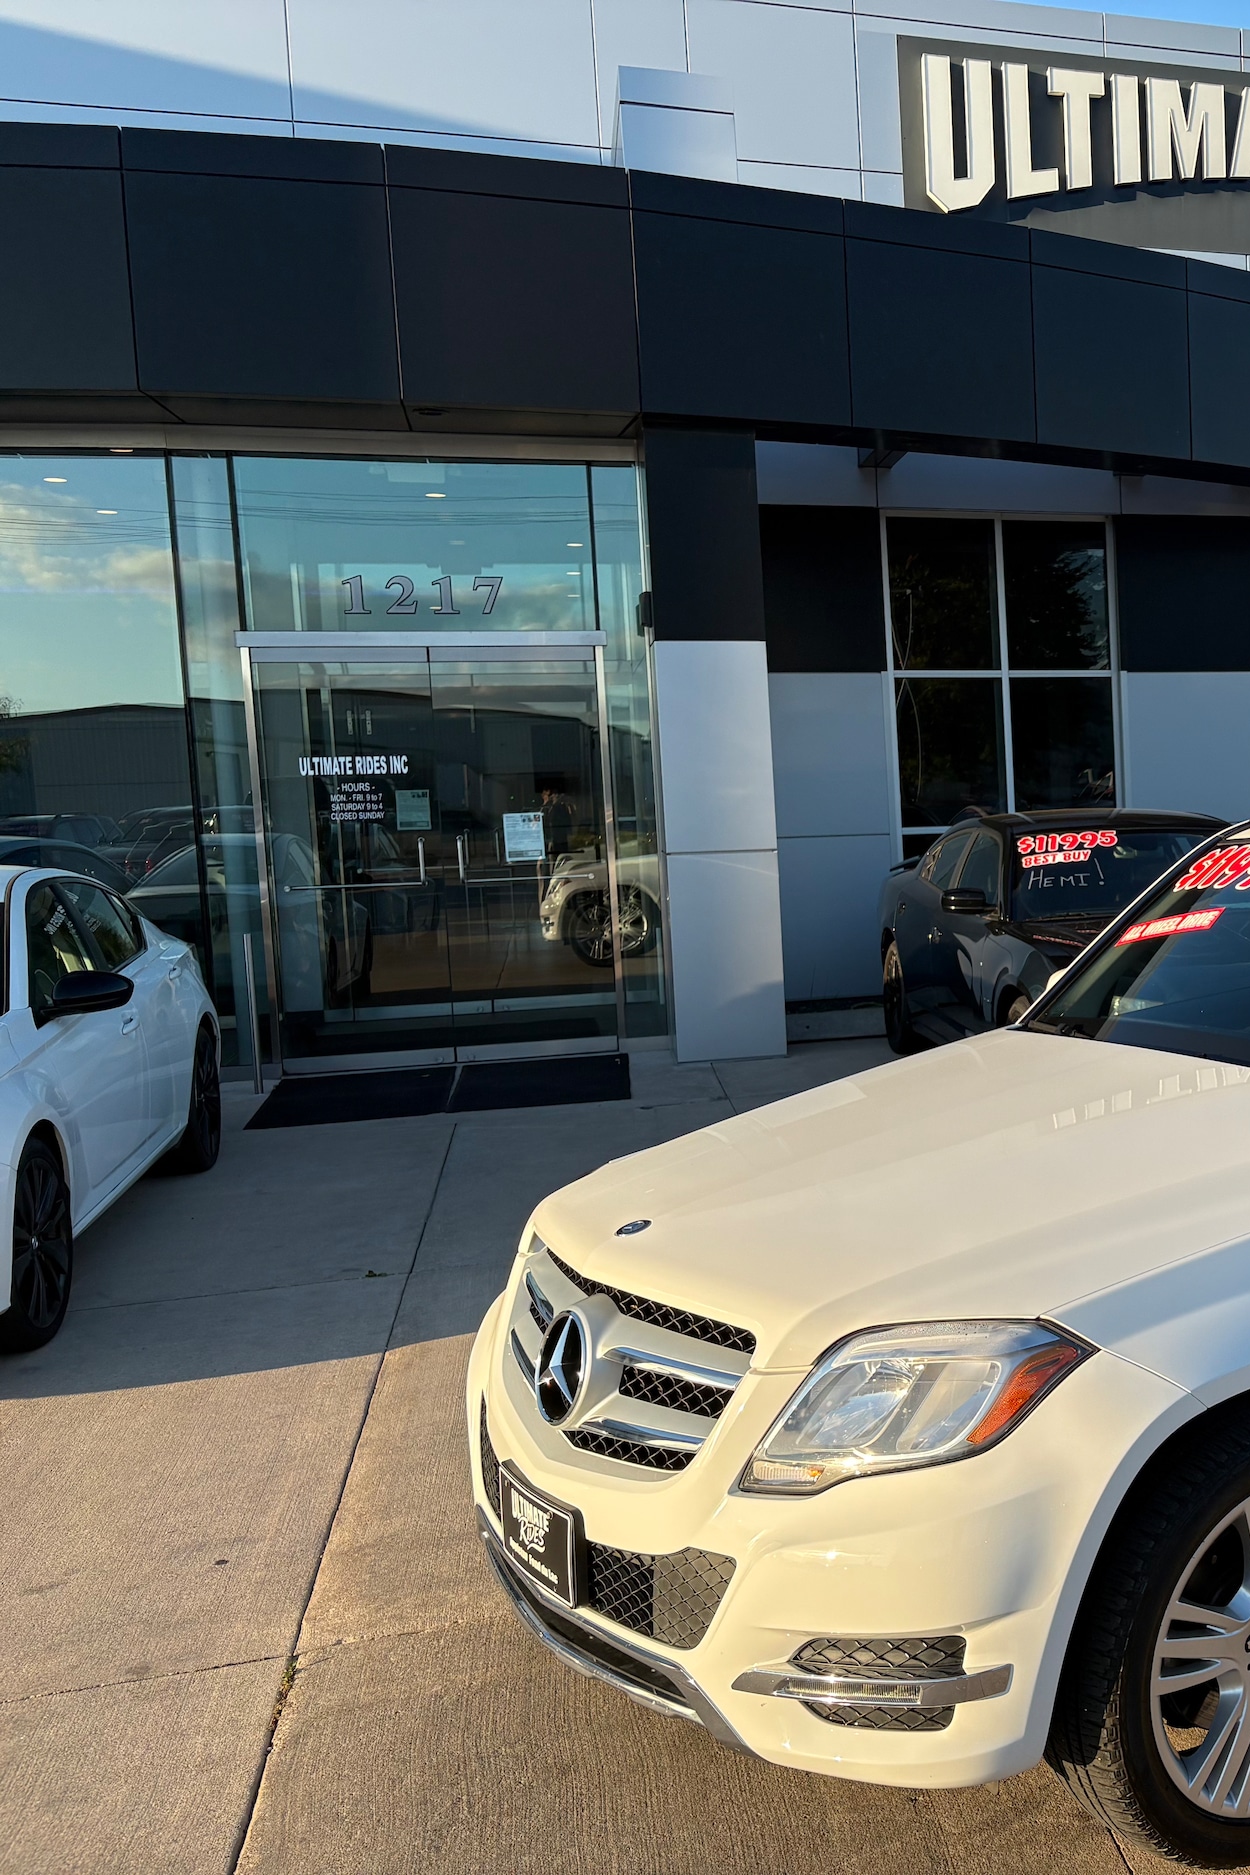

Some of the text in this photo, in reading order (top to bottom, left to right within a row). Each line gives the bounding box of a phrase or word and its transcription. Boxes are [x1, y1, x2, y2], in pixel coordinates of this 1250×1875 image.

[341, 575, 504, 616] 1217
[298, 755, 409, 777] ULTIMATE RIDES INC
[330, 794, 348, 802] MON.
[365, 793, 371, 802] 9
[371, 793, 378, 802] to
[378, 792, 383, 801] 7
[341, 782, 371, 792] HOURS
[330, 811, 386, 821] CLOSED SUNDAY
[331, 802, 384, 812] SATURDAY 9 to 4
[1017, 830, 1118, 854] $11995
[1022, 849, 1091, 868] BEST BUY
[1120, 910, 1221, 942] ALL WHEEL DRIVE
[511, 1487, 550, 1533] ULTIMATE
